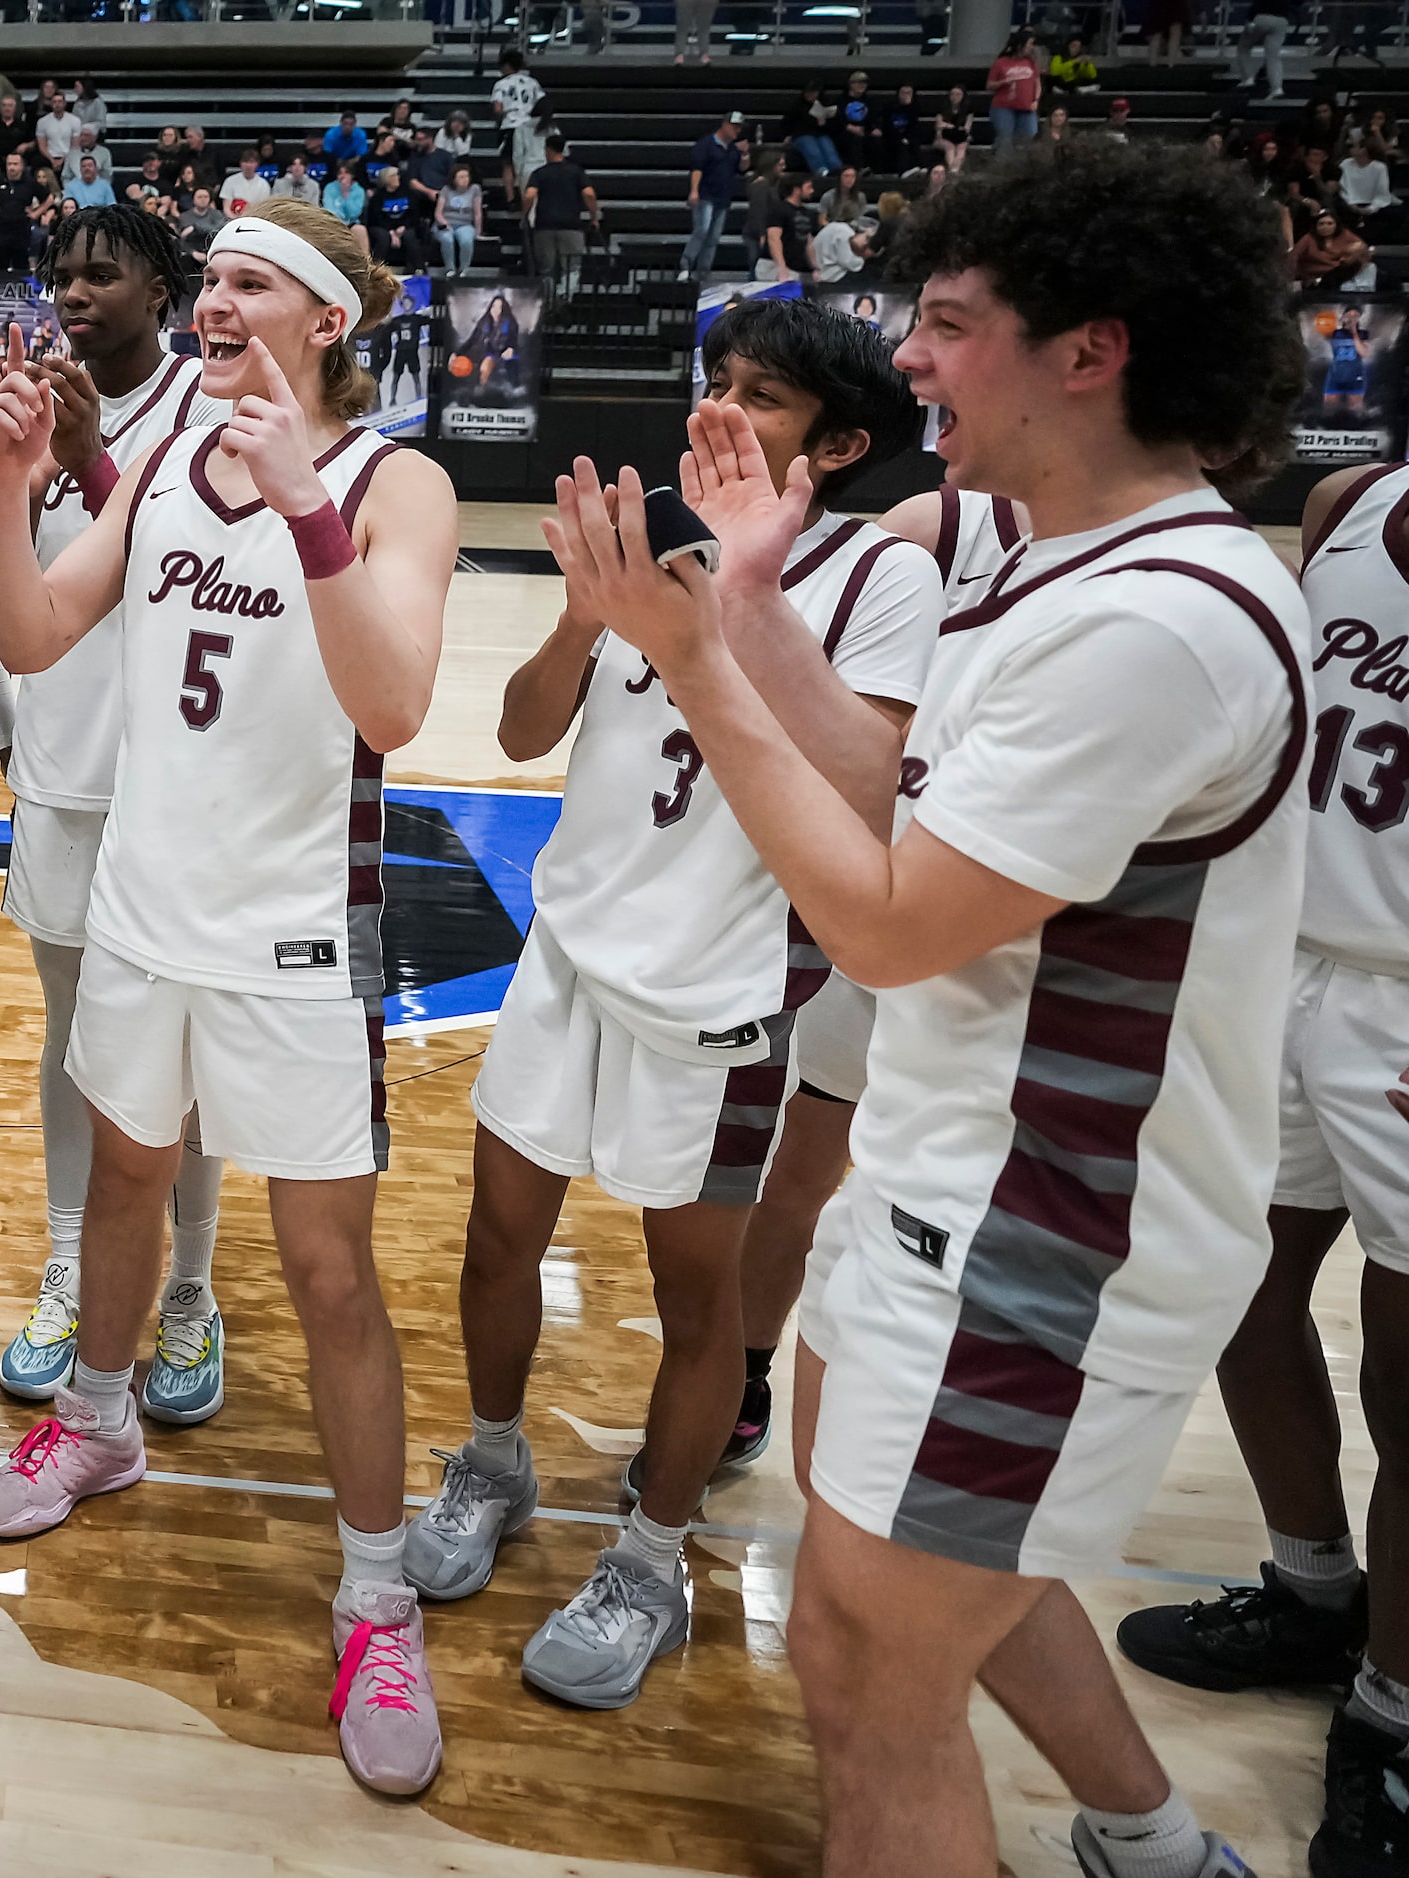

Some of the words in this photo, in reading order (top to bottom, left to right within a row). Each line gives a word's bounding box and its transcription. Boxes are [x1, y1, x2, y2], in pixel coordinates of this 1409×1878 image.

[148, 549, 285, 619] Plano
[178, 628, 234, 733] 5
[651, 728, 705, 829] 3
[1308, 704, 1409, 833] 13
[318, 948, 328, 960] L
[744, 1031, 752, 1040] L
